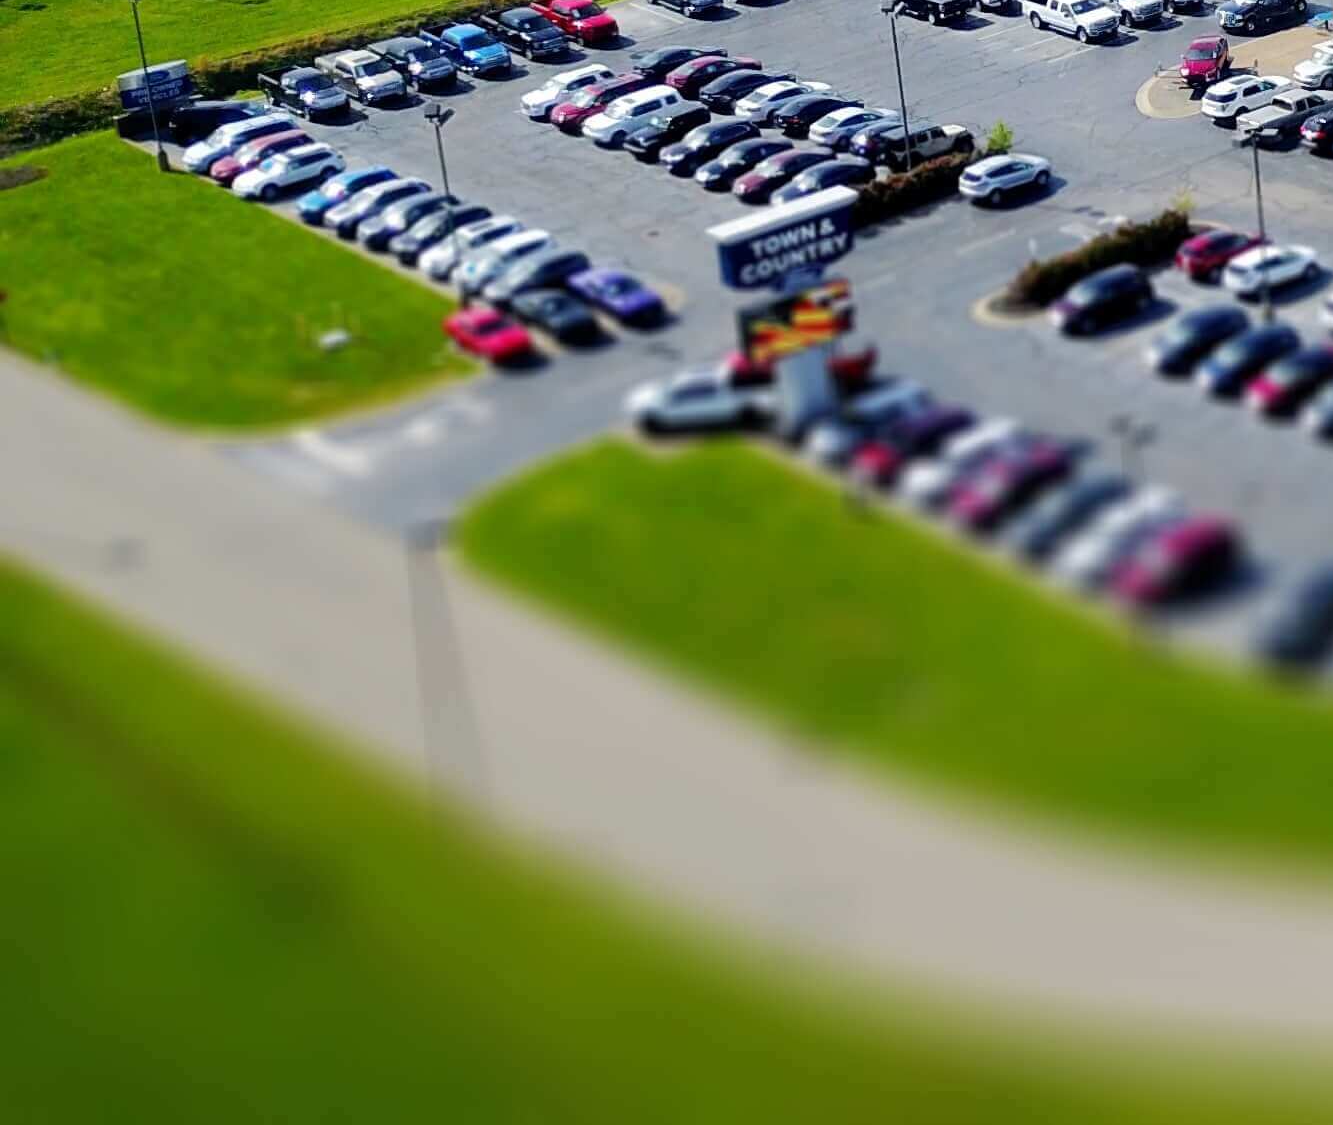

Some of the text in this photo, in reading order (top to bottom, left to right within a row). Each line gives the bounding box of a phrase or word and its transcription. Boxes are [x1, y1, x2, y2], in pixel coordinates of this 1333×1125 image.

[740, 232, 848, 284] COUNTRY
[751, 217, 835, 258] TOWN &
